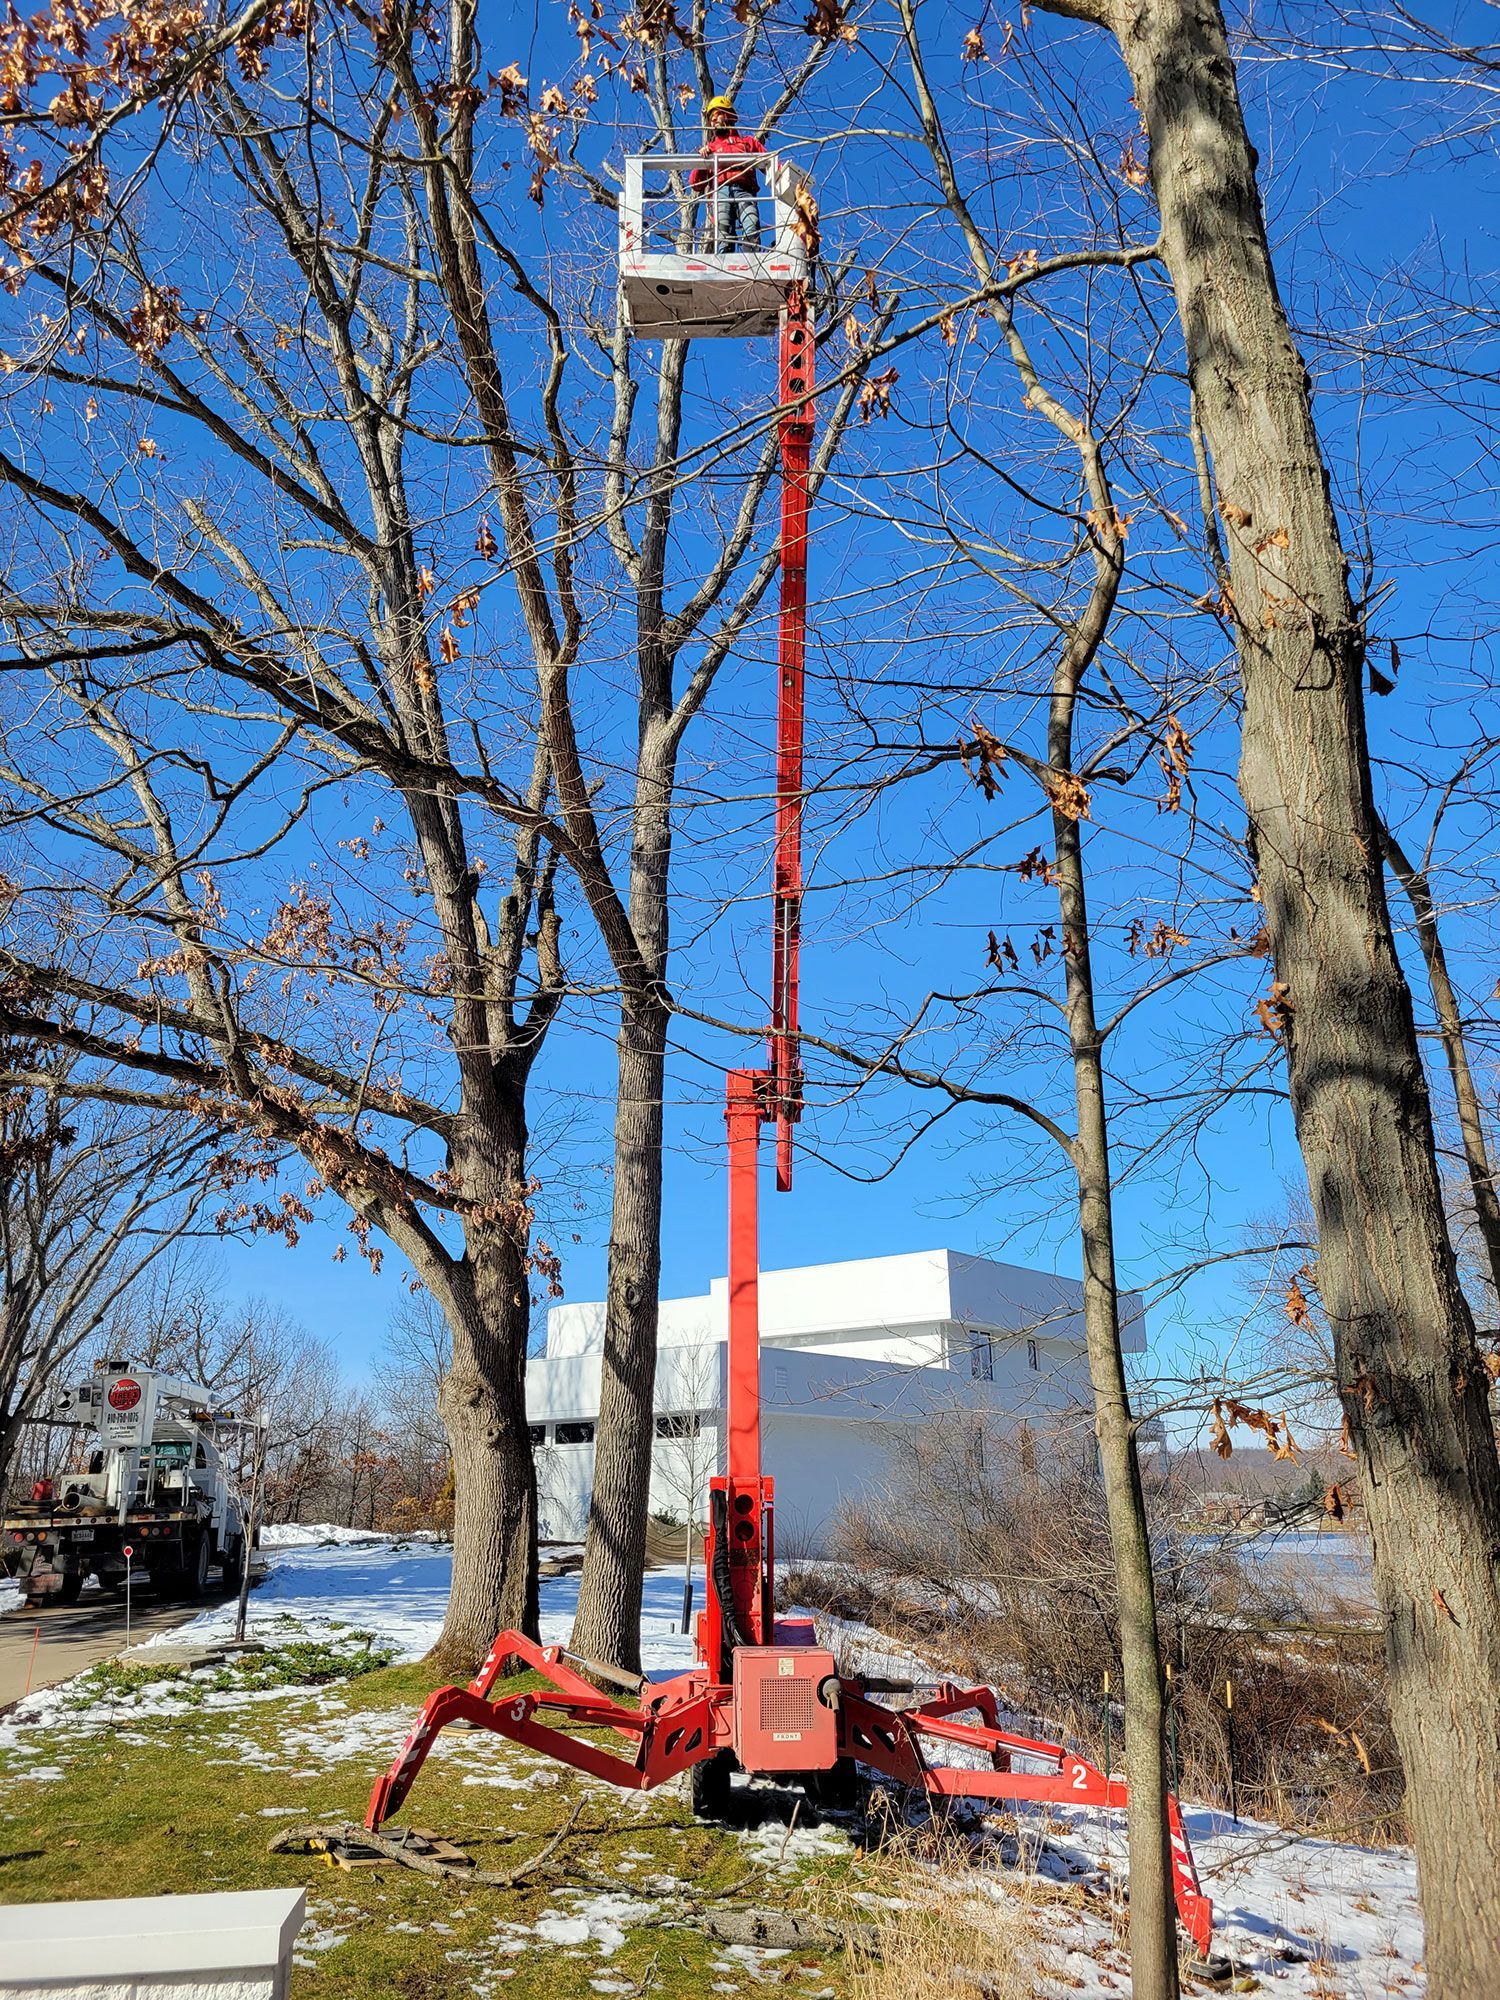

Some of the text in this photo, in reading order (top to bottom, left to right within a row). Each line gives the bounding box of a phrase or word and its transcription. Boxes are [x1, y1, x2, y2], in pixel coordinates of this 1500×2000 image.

[542, 1647, 553, 1663] 4
[510, 1697, 527, 1722] 3
[1071, 1764, 1088, 1790] 2
